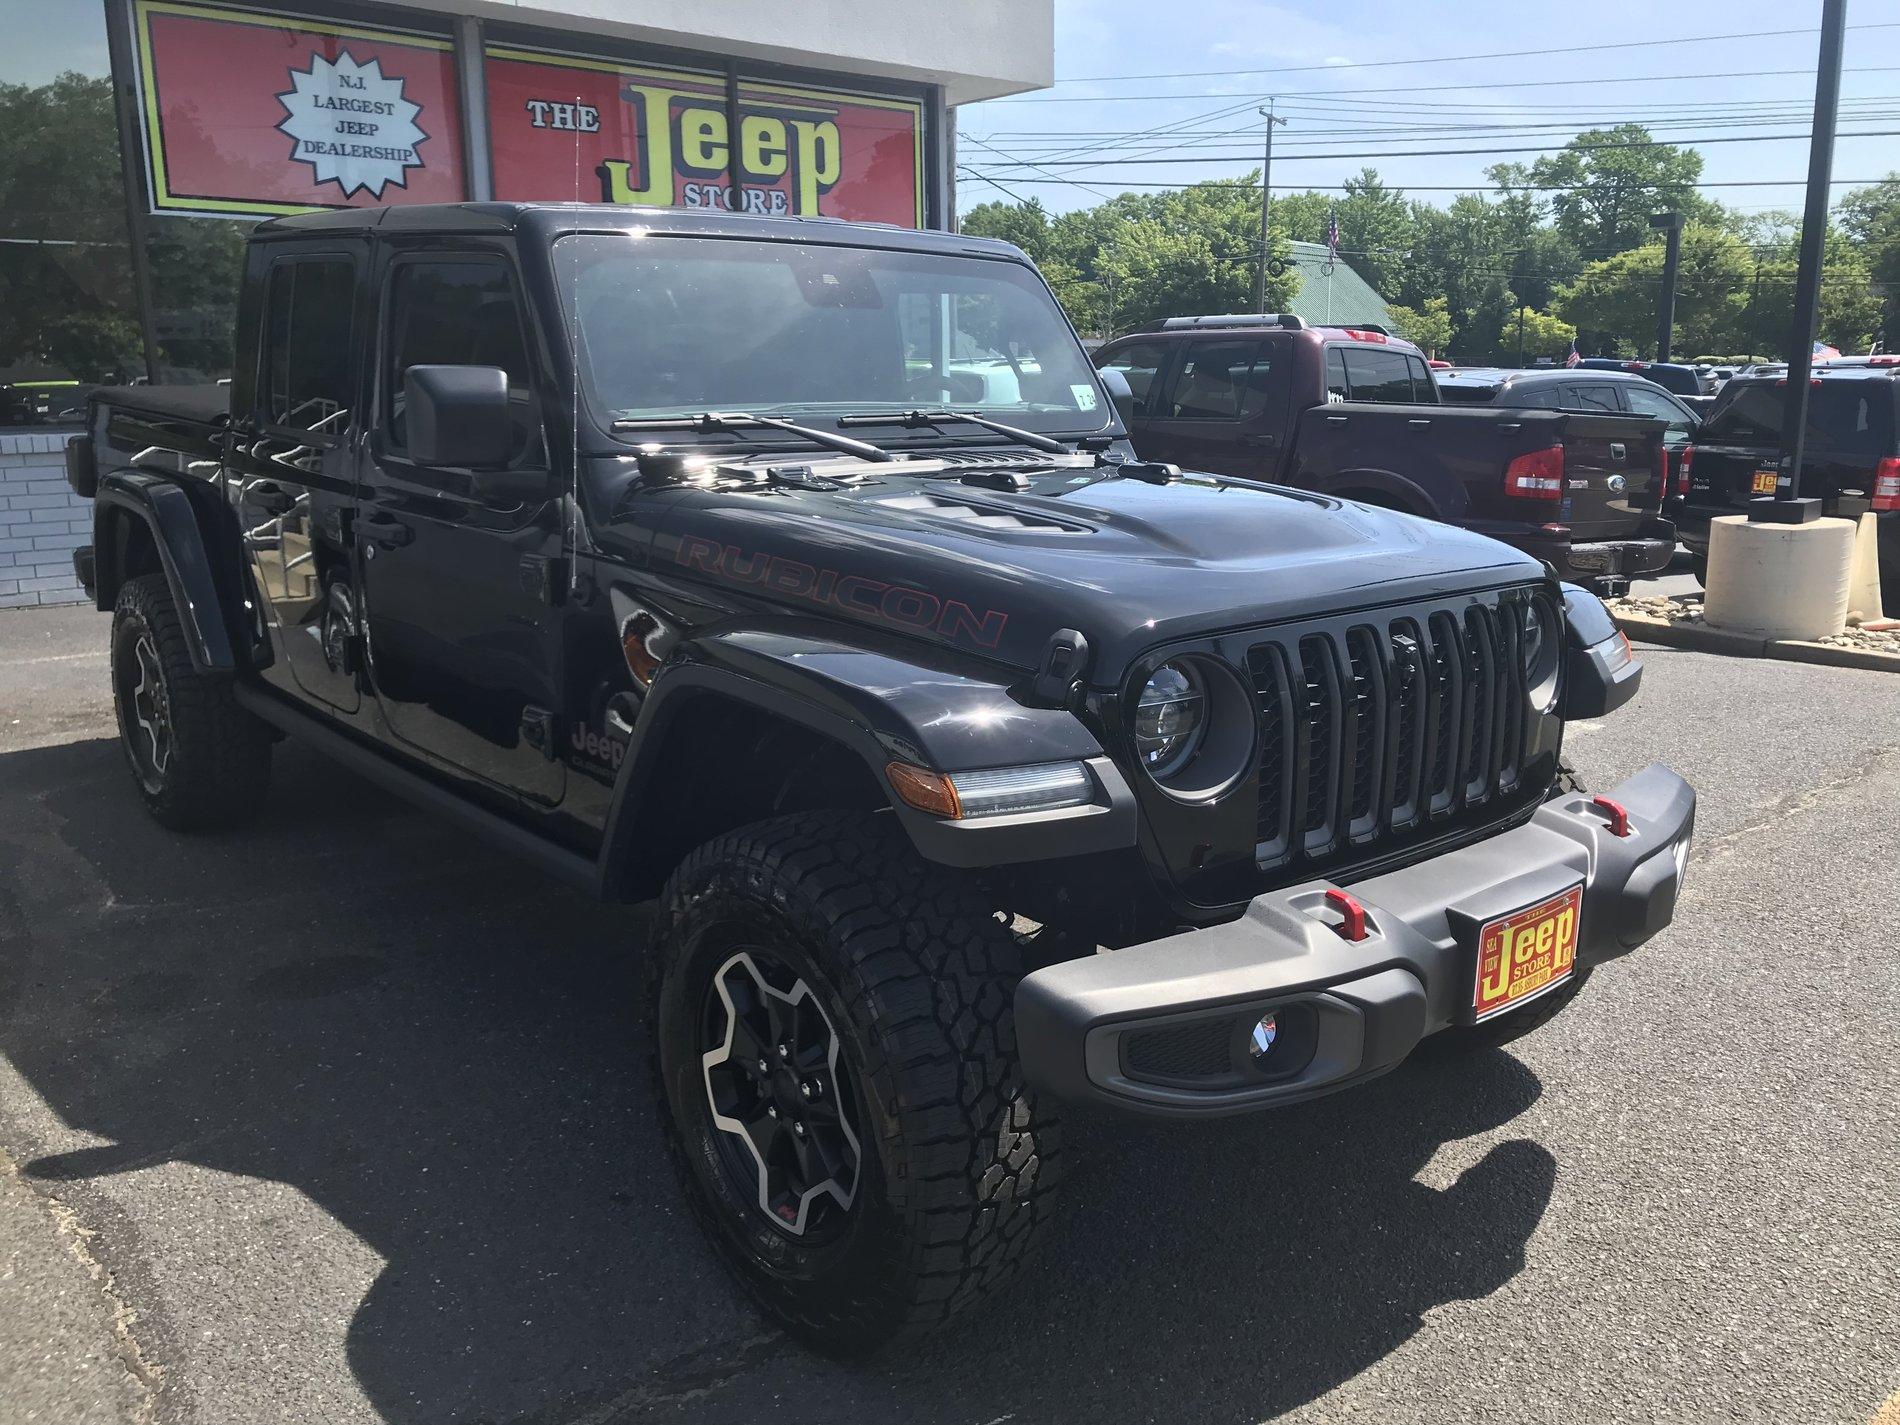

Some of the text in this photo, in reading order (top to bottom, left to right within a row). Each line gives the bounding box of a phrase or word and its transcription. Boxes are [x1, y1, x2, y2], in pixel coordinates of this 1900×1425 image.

[338, 74, 367, 91] N.J.
[313, 95, 395, 116] LARGEST
[527, 99, 600, 132] THE
[335, 120, 379, 137] JEEP
[302, 140, 414, 162] DEALERSHIP
[602, 84, 840, 217] Jeep
[683, 183, 788, 215] STORE
[1753, 473, 1777, 490] Je
[675, 533, 1009, 648] RUBICON
[571, 721, 625, 769] Jeep
[1481, 906, 1574, 1002] Jeep
[1513, 952, 1551, 980] STORE
